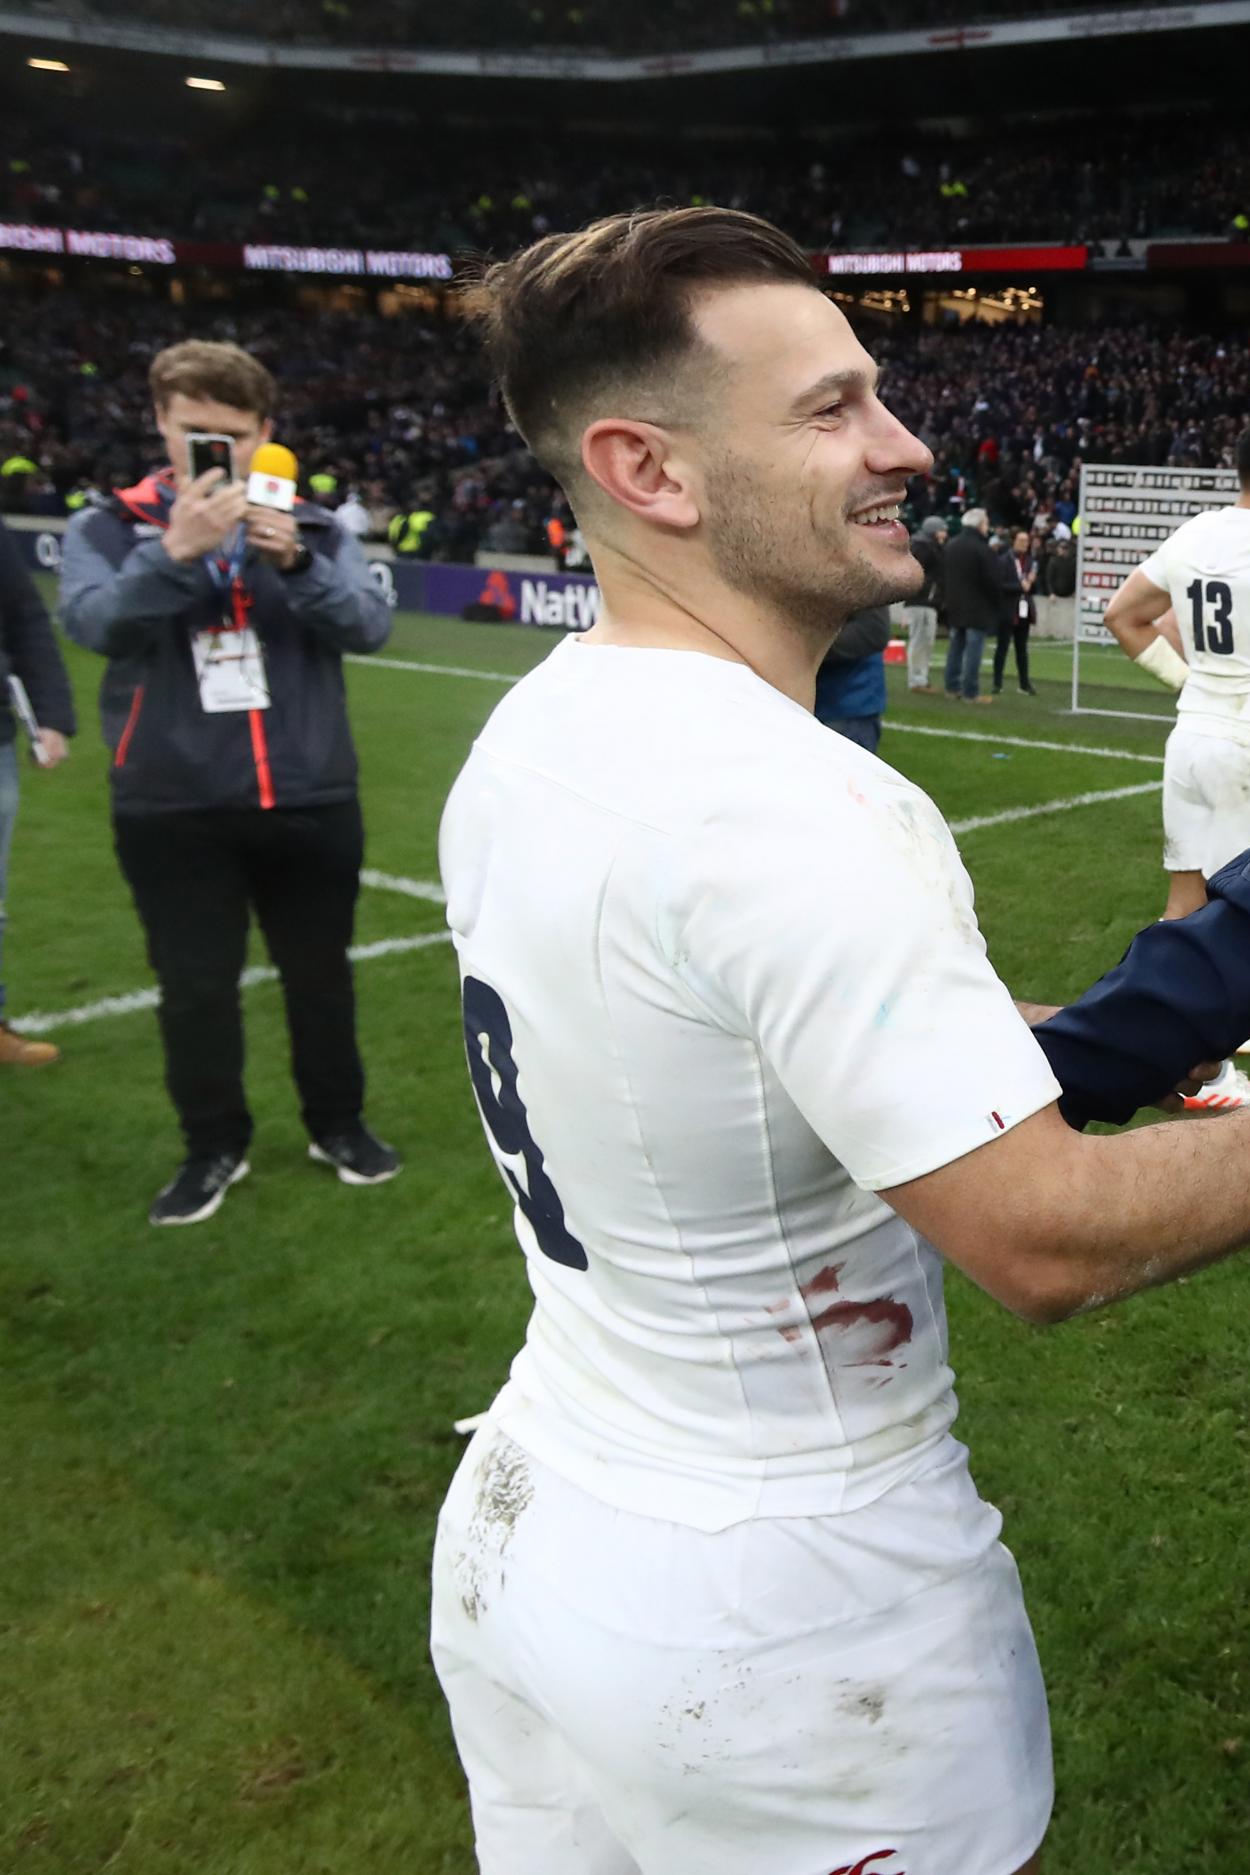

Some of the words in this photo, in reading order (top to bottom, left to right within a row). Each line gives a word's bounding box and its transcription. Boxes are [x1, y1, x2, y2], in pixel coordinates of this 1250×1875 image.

[66, 229, 176, 264] MOTORS
[366, 251, 453, 279] MOTORS
[906, 252, 963, 273] MOTORS
[1187, 578, 1234, 655] 13
